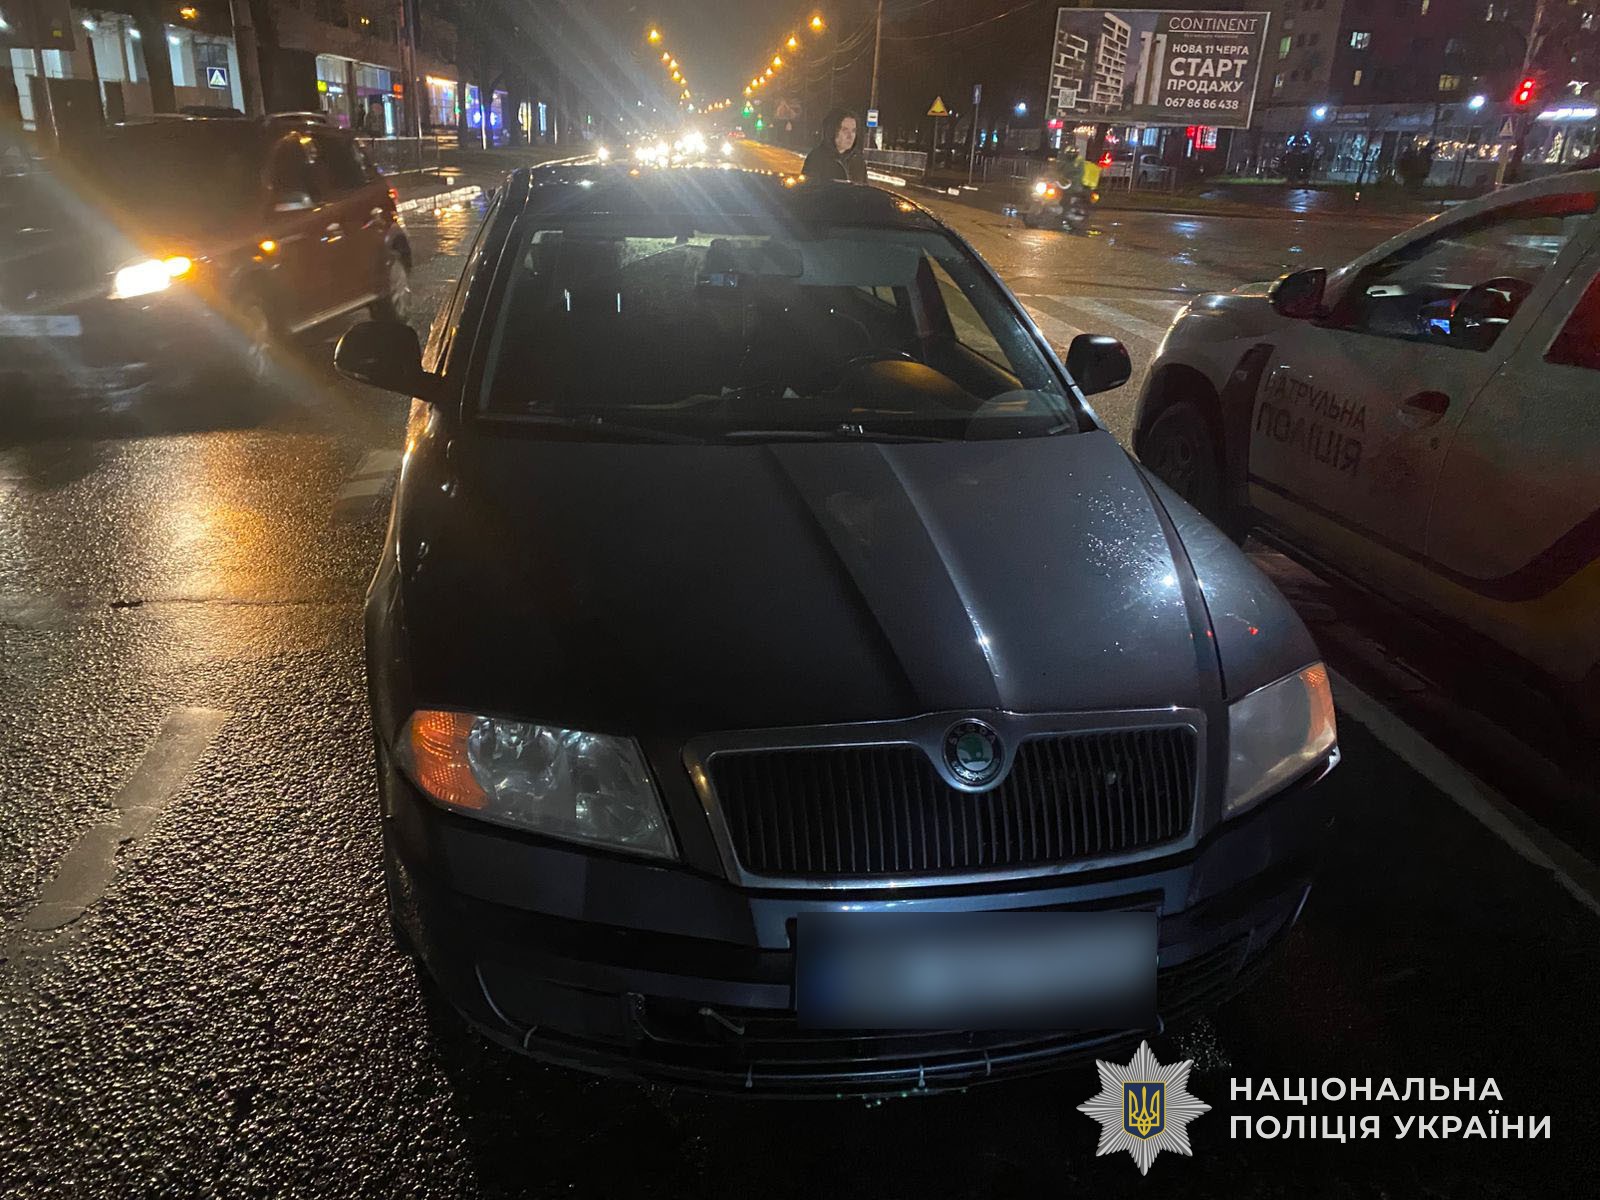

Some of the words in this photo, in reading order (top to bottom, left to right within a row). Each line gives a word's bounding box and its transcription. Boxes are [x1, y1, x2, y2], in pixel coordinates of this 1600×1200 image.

[1169, 17, 1258, 31] CONTINENT
[1172, 44, 1203, 54] НОВА
[1205, 45, 1215, 54] 11
[1216, 45, 1249, 55] ЧЕРГА
[1170, 57, 1248, 78] СТАРТ
[1167, 79, 1244, 94] ПРОДАЖУ
[1165, 97, 1186, 108] 067
[1187, 98, 1201, 108] 86
[1202, 99, 1217, 109] 86
[1218, 99, 1239, 110] 438
